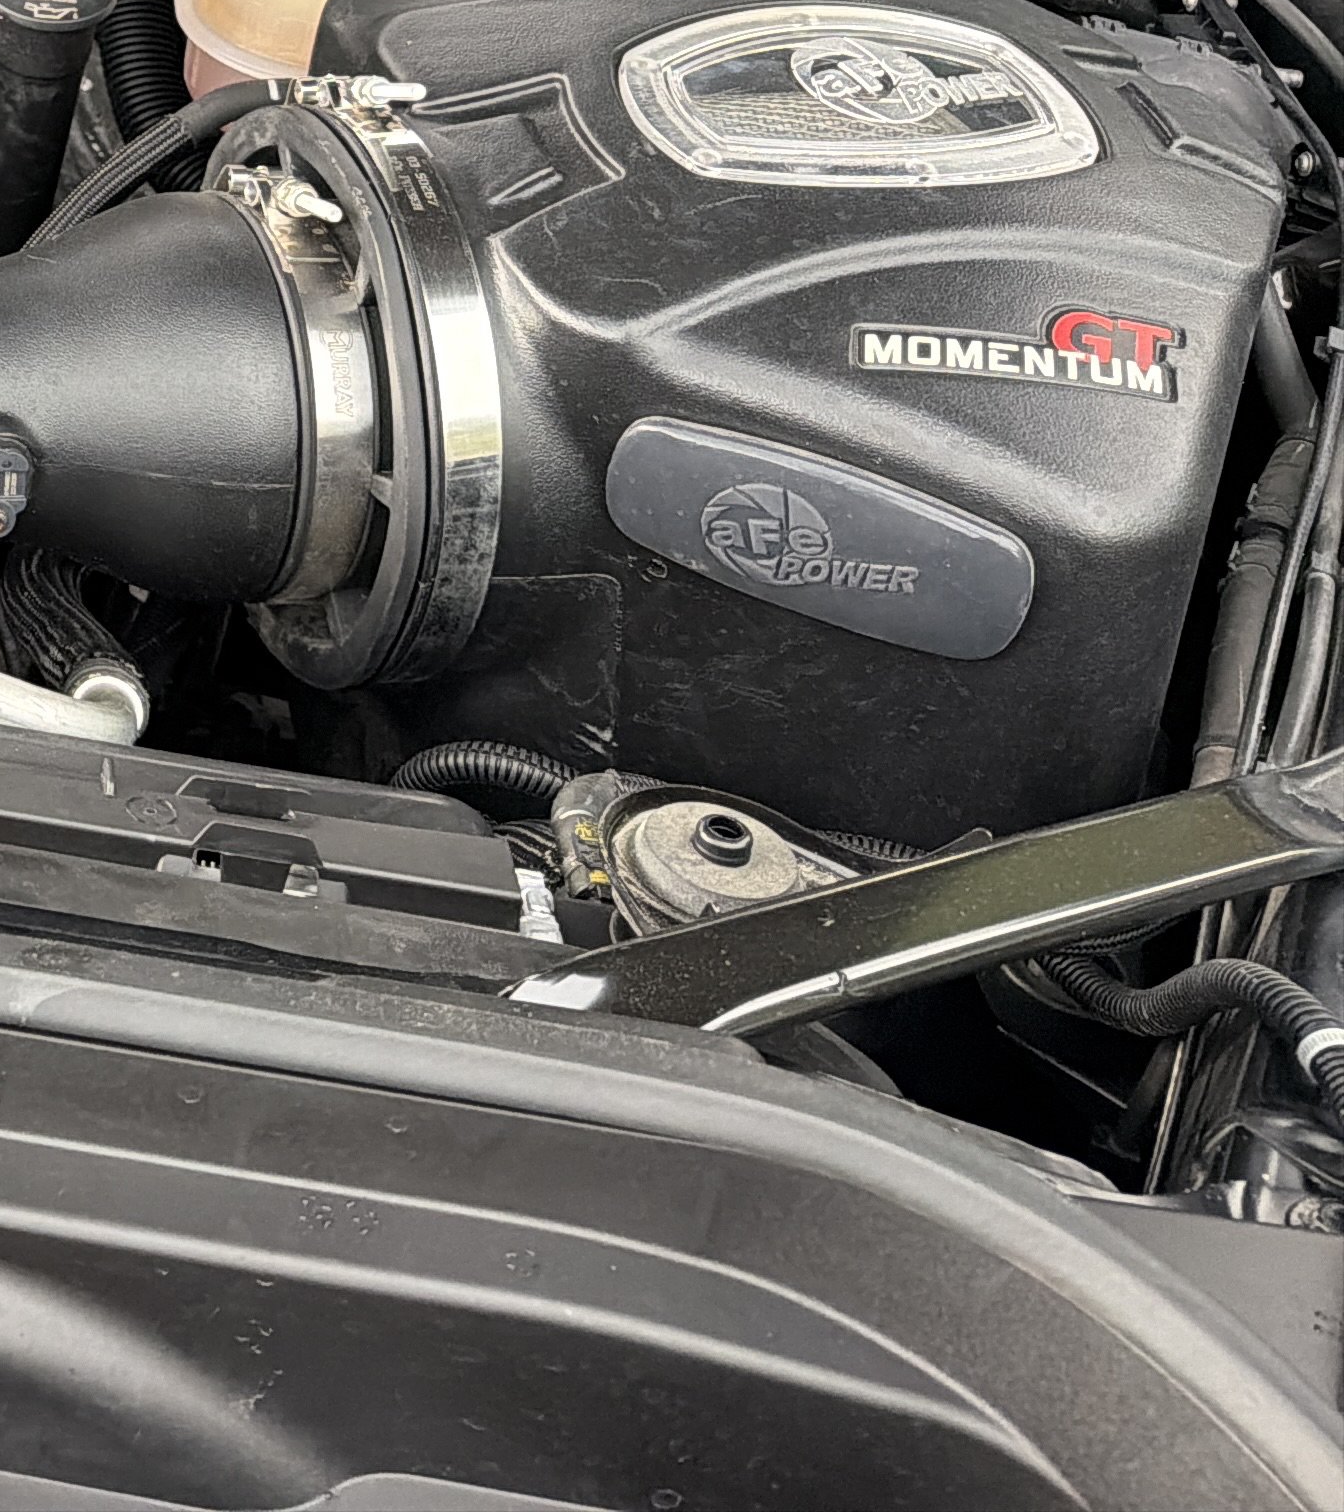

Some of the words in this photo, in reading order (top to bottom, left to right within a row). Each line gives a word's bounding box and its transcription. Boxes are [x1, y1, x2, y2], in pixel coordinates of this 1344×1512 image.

[896, 71, 1024, 114] POWER
[325, 329, 354, 418] MURRAY
[864, 333, 1163, 394] MOMENTUM
[1052, 311, 1173, 371] GT
[776, 557, 920, 594] POWER
